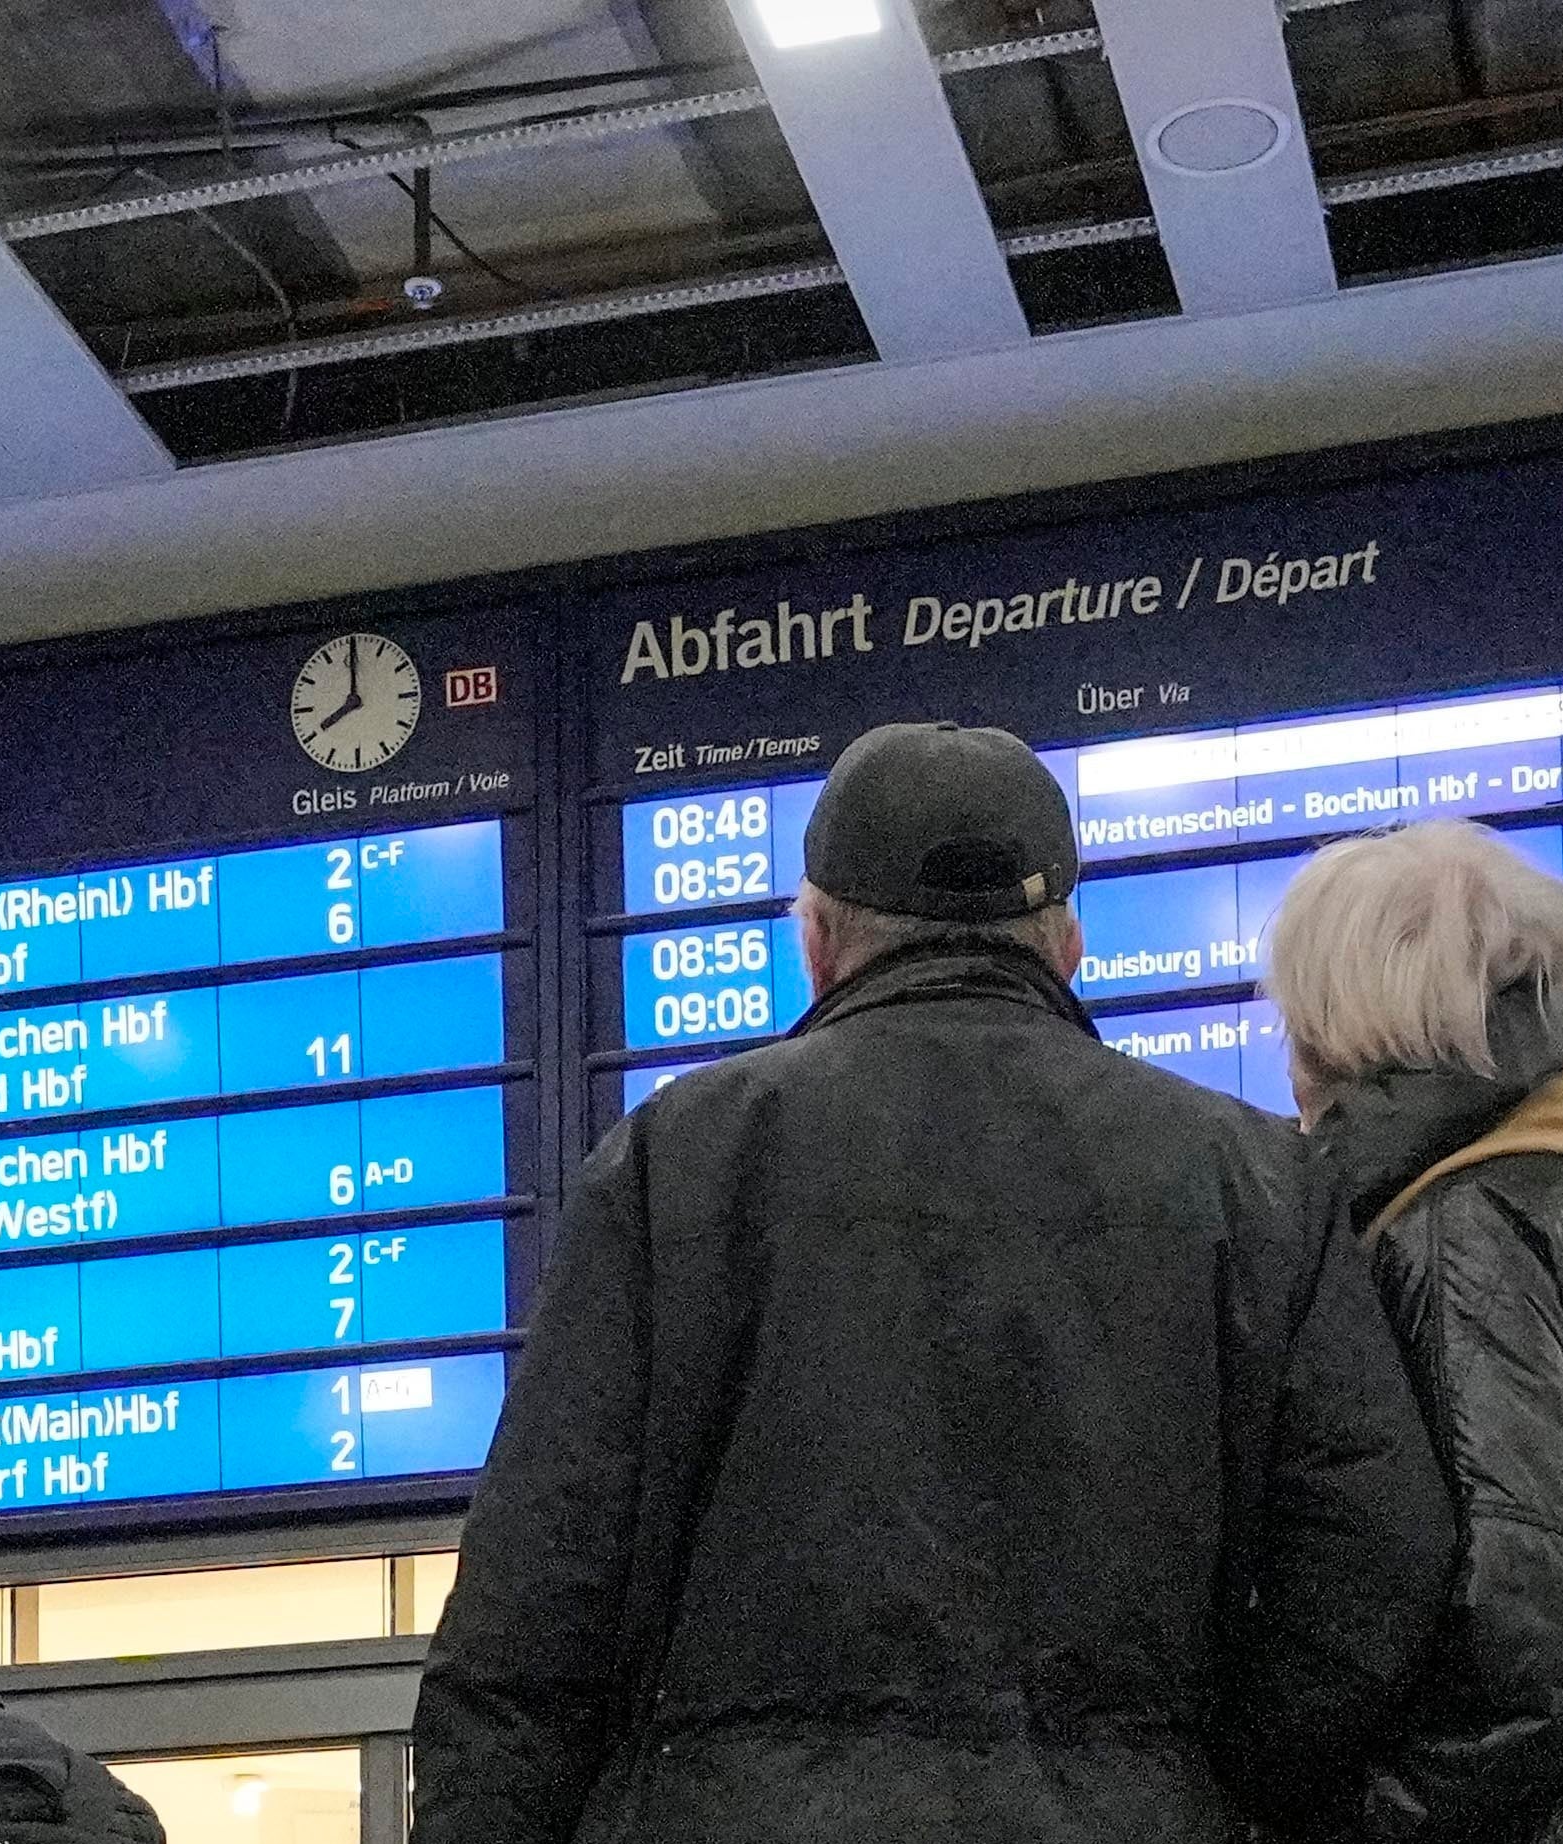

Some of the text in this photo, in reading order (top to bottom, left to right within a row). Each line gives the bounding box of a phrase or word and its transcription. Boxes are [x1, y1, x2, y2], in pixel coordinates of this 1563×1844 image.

[903, 539, 1379, 648] Departure / Départ
[620, 594, 873, 685] Abfahrt
[450, 671, 494, 704] DB
[1078, 682, 1144, 716] Über
[1159, 682, 1191, 707] Via
[634, 743, 685, 774] Zeit
[292, 786, 357, 817] Gleis
[369, 775, 451, 807] Platform
[470, 769, 510, 793] Voie
[653, 797, 768, 848] 08:48
[1079, 798, 1273, 847] Wattenscheid
[1305, 783, 1419, 820] Bochum
[1428, 772, 1478, 802] Hbf
[326, 848, 352, 891] 2
[361, 839, 407, 871] C-F
[148, 866, 213, 912] Hbf
[654, 853, 769, 903] 08:52
[327, 903, 354, 945] 6
[653, 929, 767, 981] 08:56
[1081, 938, 1258, 982] Duisburg Hbf
[102, 1002, 168, 1047] Hbf
[654, 986, 769, 1037] 09:08
[305, 1034, 351, 1078] 11
[1200, 1020, 1249, 1050] Hbf
[23, 1066, 87, 1110] Hbf
[103, 1130, 168, 1175] Hbf
[365, 1158, 415, 1187] A-D
[329, 1166, 354, 1205] 6
[327, 1244, 354, 1285] 2
[363, 1237, 407, 1266] C-F
[329, 1298, 354, 1339] 7
[330, 1375, 352, 1416] 1
[330, 1430, 355, 1471] 2
[44, 1452, 108, 1495] Hbf
